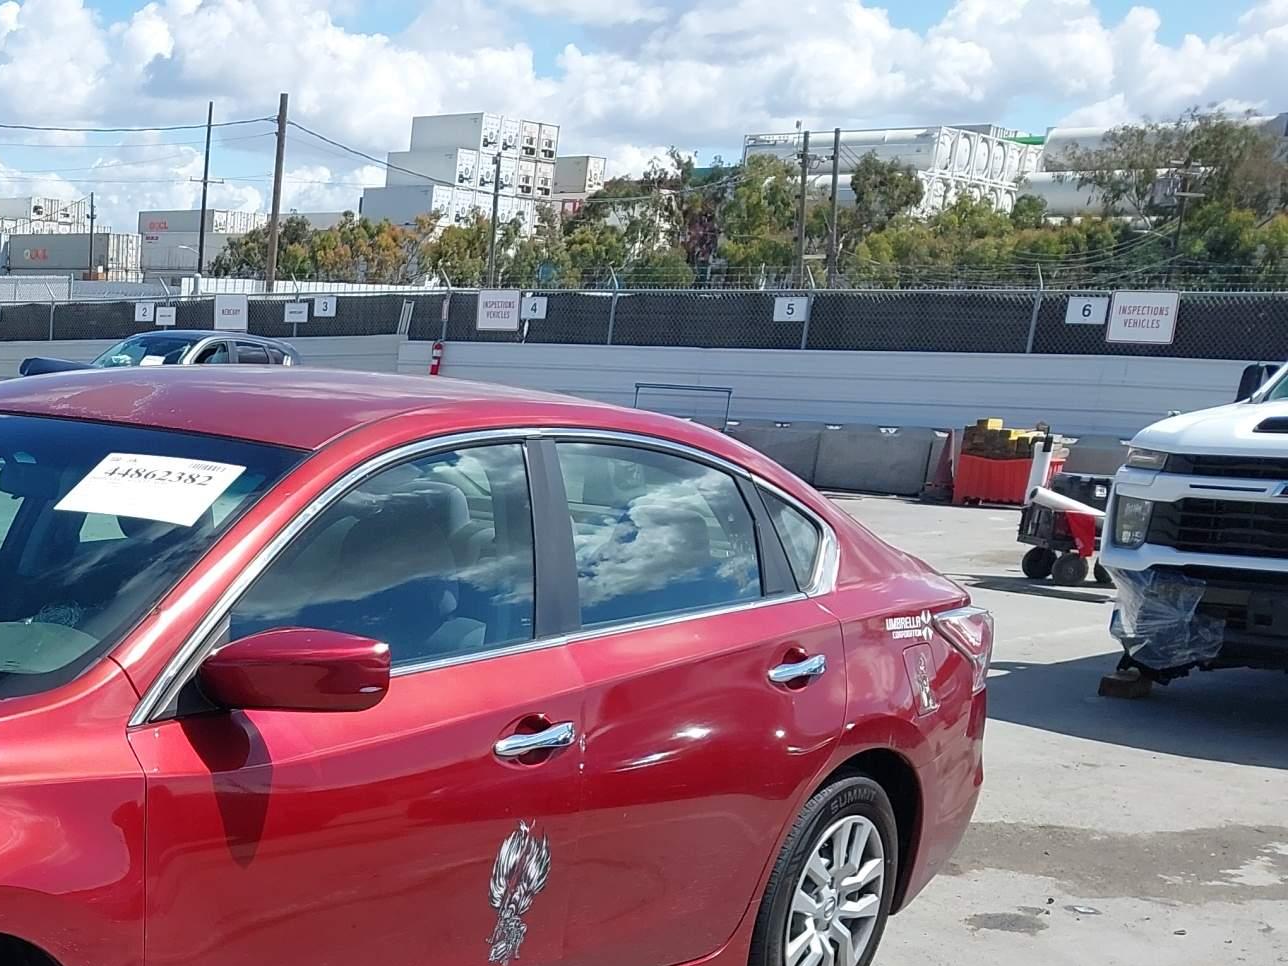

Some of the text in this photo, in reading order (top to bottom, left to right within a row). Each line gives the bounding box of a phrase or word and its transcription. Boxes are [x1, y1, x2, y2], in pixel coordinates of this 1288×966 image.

[142, 307, 148, 317] 2
[322, 301, 329, 312] 3
[530, 302, 537, 313] 4
[786, 303, 795, 315] 5
[1081, 304, 1092, 317] 6
[1118, 305, 1170, 316] INSPECTIONS
[1123, 318, 1161, 329] VEHICLES
[104, 466, 213, 486] 44862382
[885, 616, 921, 630] UMBRELLA
[831, 788, 877, 815] SUMMIT
